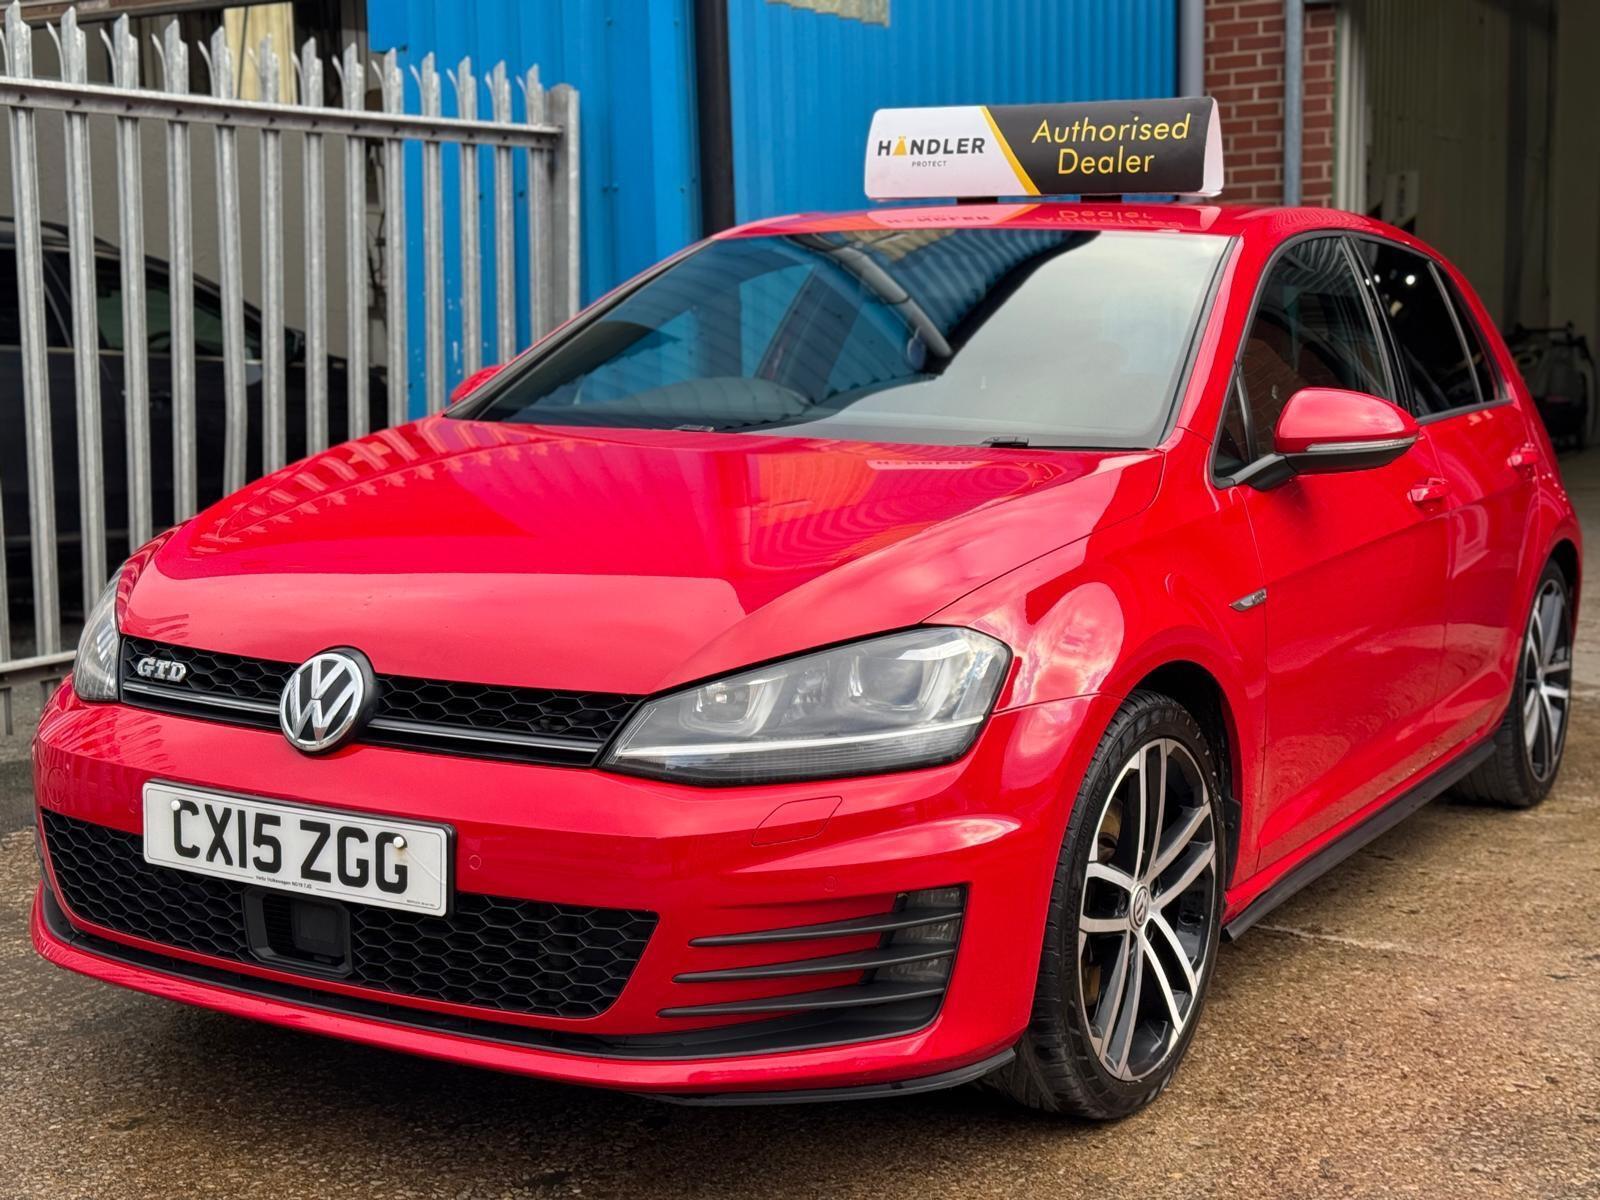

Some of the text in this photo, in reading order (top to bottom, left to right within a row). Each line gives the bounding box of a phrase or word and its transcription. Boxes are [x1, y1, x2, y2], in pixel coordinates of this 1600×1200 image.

[1031, 112, 1191, 143] Authorised
[911, 160, 948, 168] PROTECT
[1058, 145, 1155, 175] Dealer
[137, 656, 186, 682] GTD
[172, 799, 409, 895] CX15 ZGG
